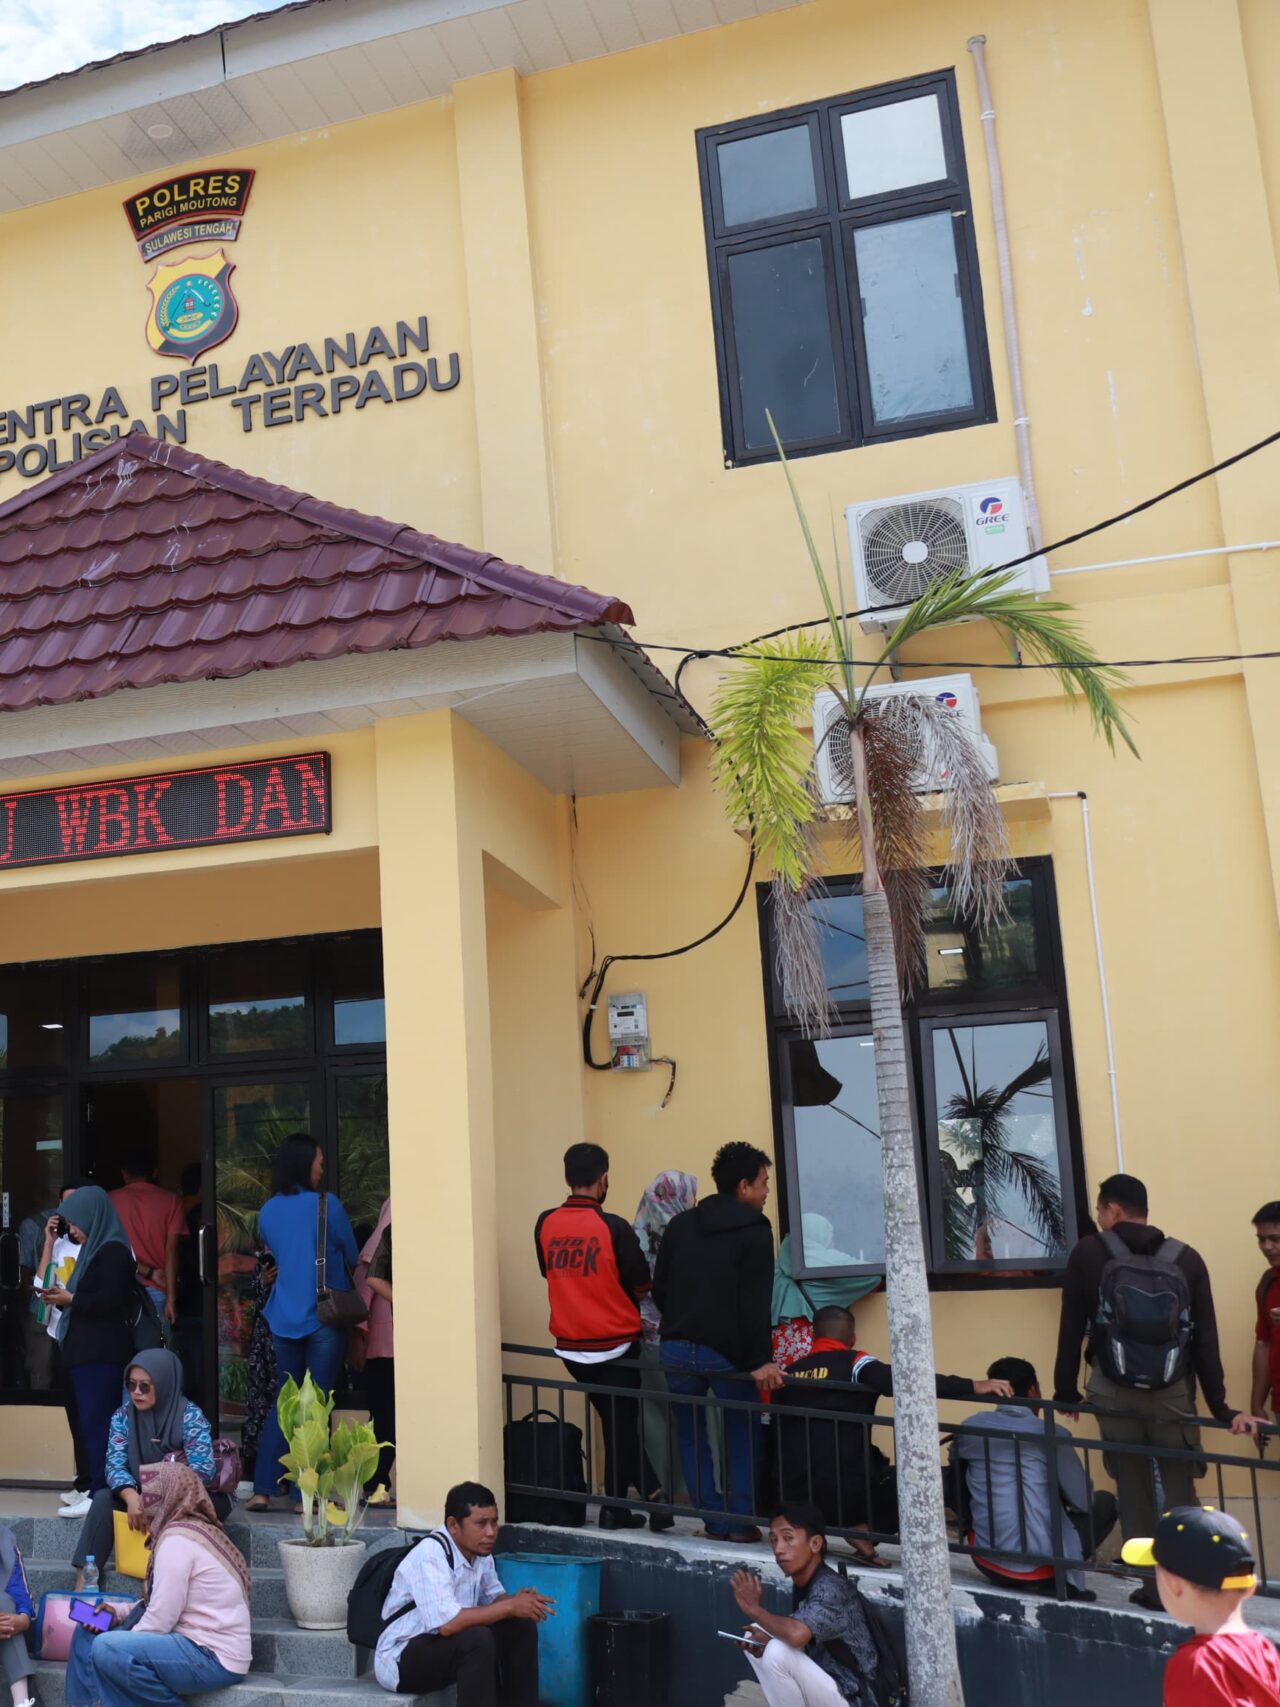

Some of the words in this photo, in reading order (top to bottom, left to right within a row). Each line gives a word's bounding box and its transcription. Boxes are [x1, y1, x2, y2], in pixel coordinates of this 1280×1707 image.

[135, 175, 241, 217] POLRES
[140, 206, 177, 228] PARIGI
[179, 197, 237, 213] MOUTONG
[145, 228, 192, 253] SULAWESI
[194, 221, 233, 237] TENGAH
[150, 316, 430, 411] PELAYANAN
[230, 352, 461, 433] TERPADU
[976, 514, 1008, 525] GREE
[54, 781, 174, 854] WBK
[212, 762, 325, 836] DAN
[547, 1247, 601, 1277] ROCK
